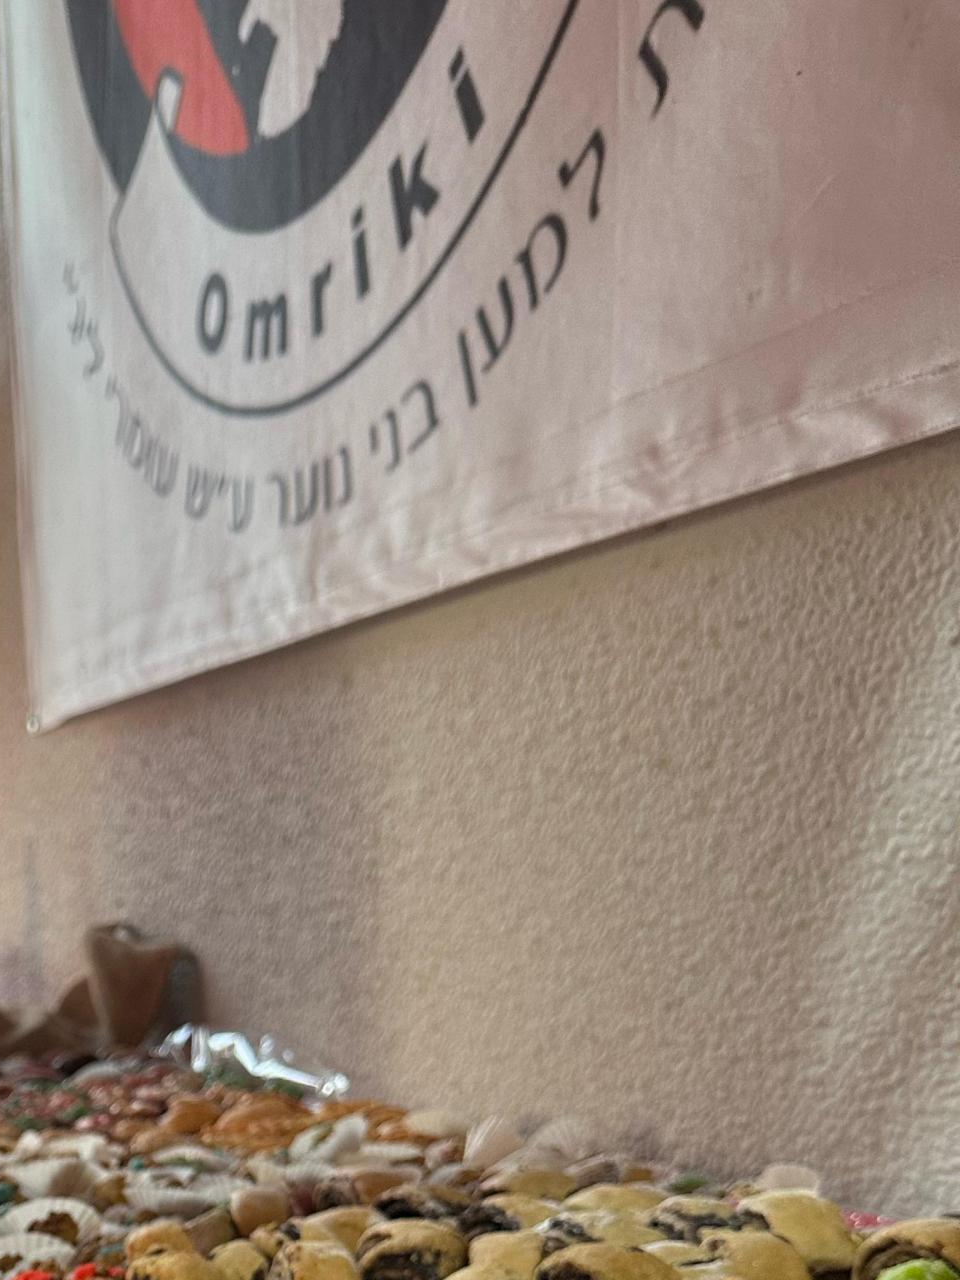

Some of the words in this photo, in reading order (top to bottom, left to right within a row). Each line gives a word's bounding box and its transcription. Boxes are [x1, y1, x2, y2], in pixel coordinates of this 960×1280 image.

[197, 46, 485, 363] Omriki
[456, 127, 606, 409] למען
[267, 447, 352, 529] נוער
[367, 380, 441, 473] בני
